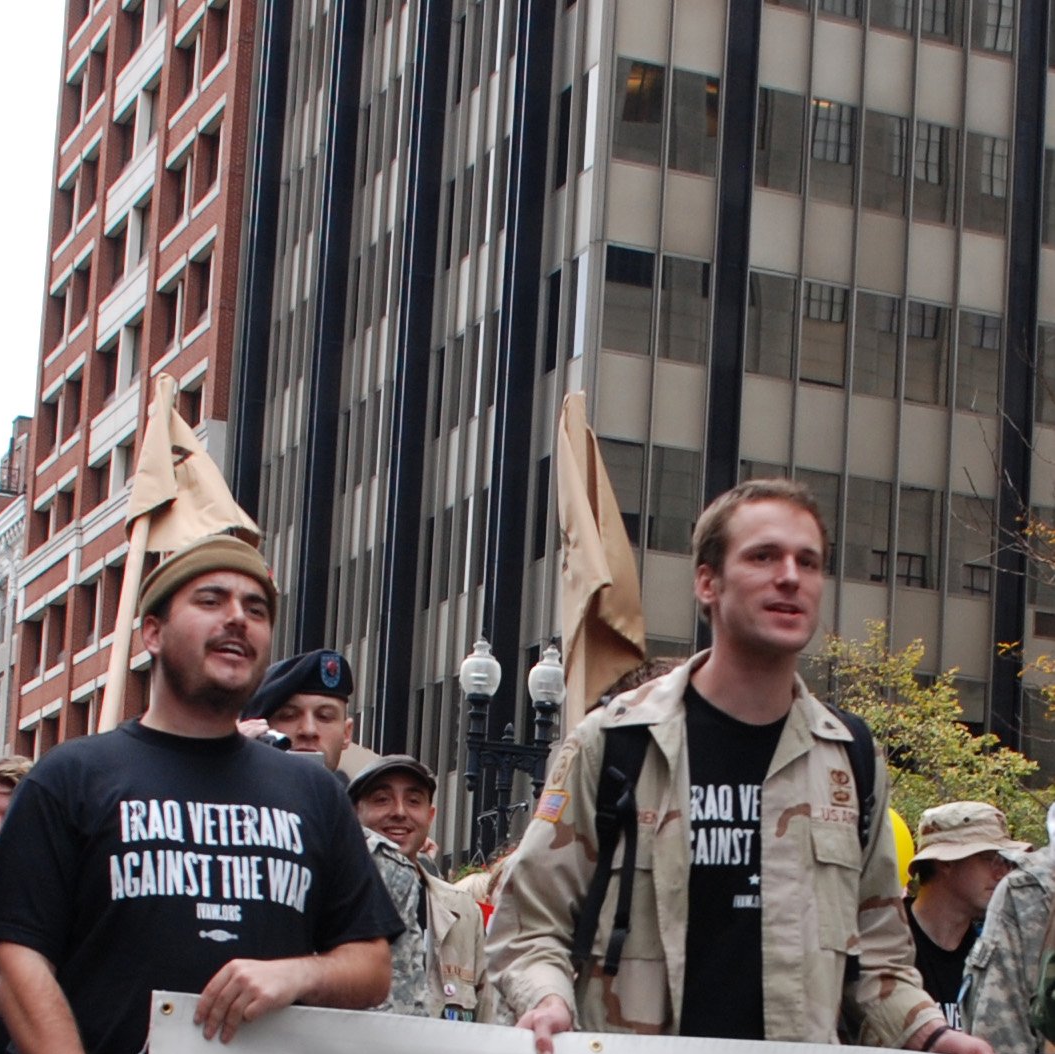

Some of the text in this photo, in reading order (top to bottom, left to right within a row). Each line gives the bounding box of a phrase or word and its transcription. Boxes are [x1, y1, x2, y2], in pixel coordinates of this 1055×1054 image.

[690, 784, 734, 822] RAQ
[120, 799, 304, 855] IRAQ VETERANS
[109, 850, 313, 914] AGAINST THE WAR
[196, 902, 242, 922] IVAW.ORG
